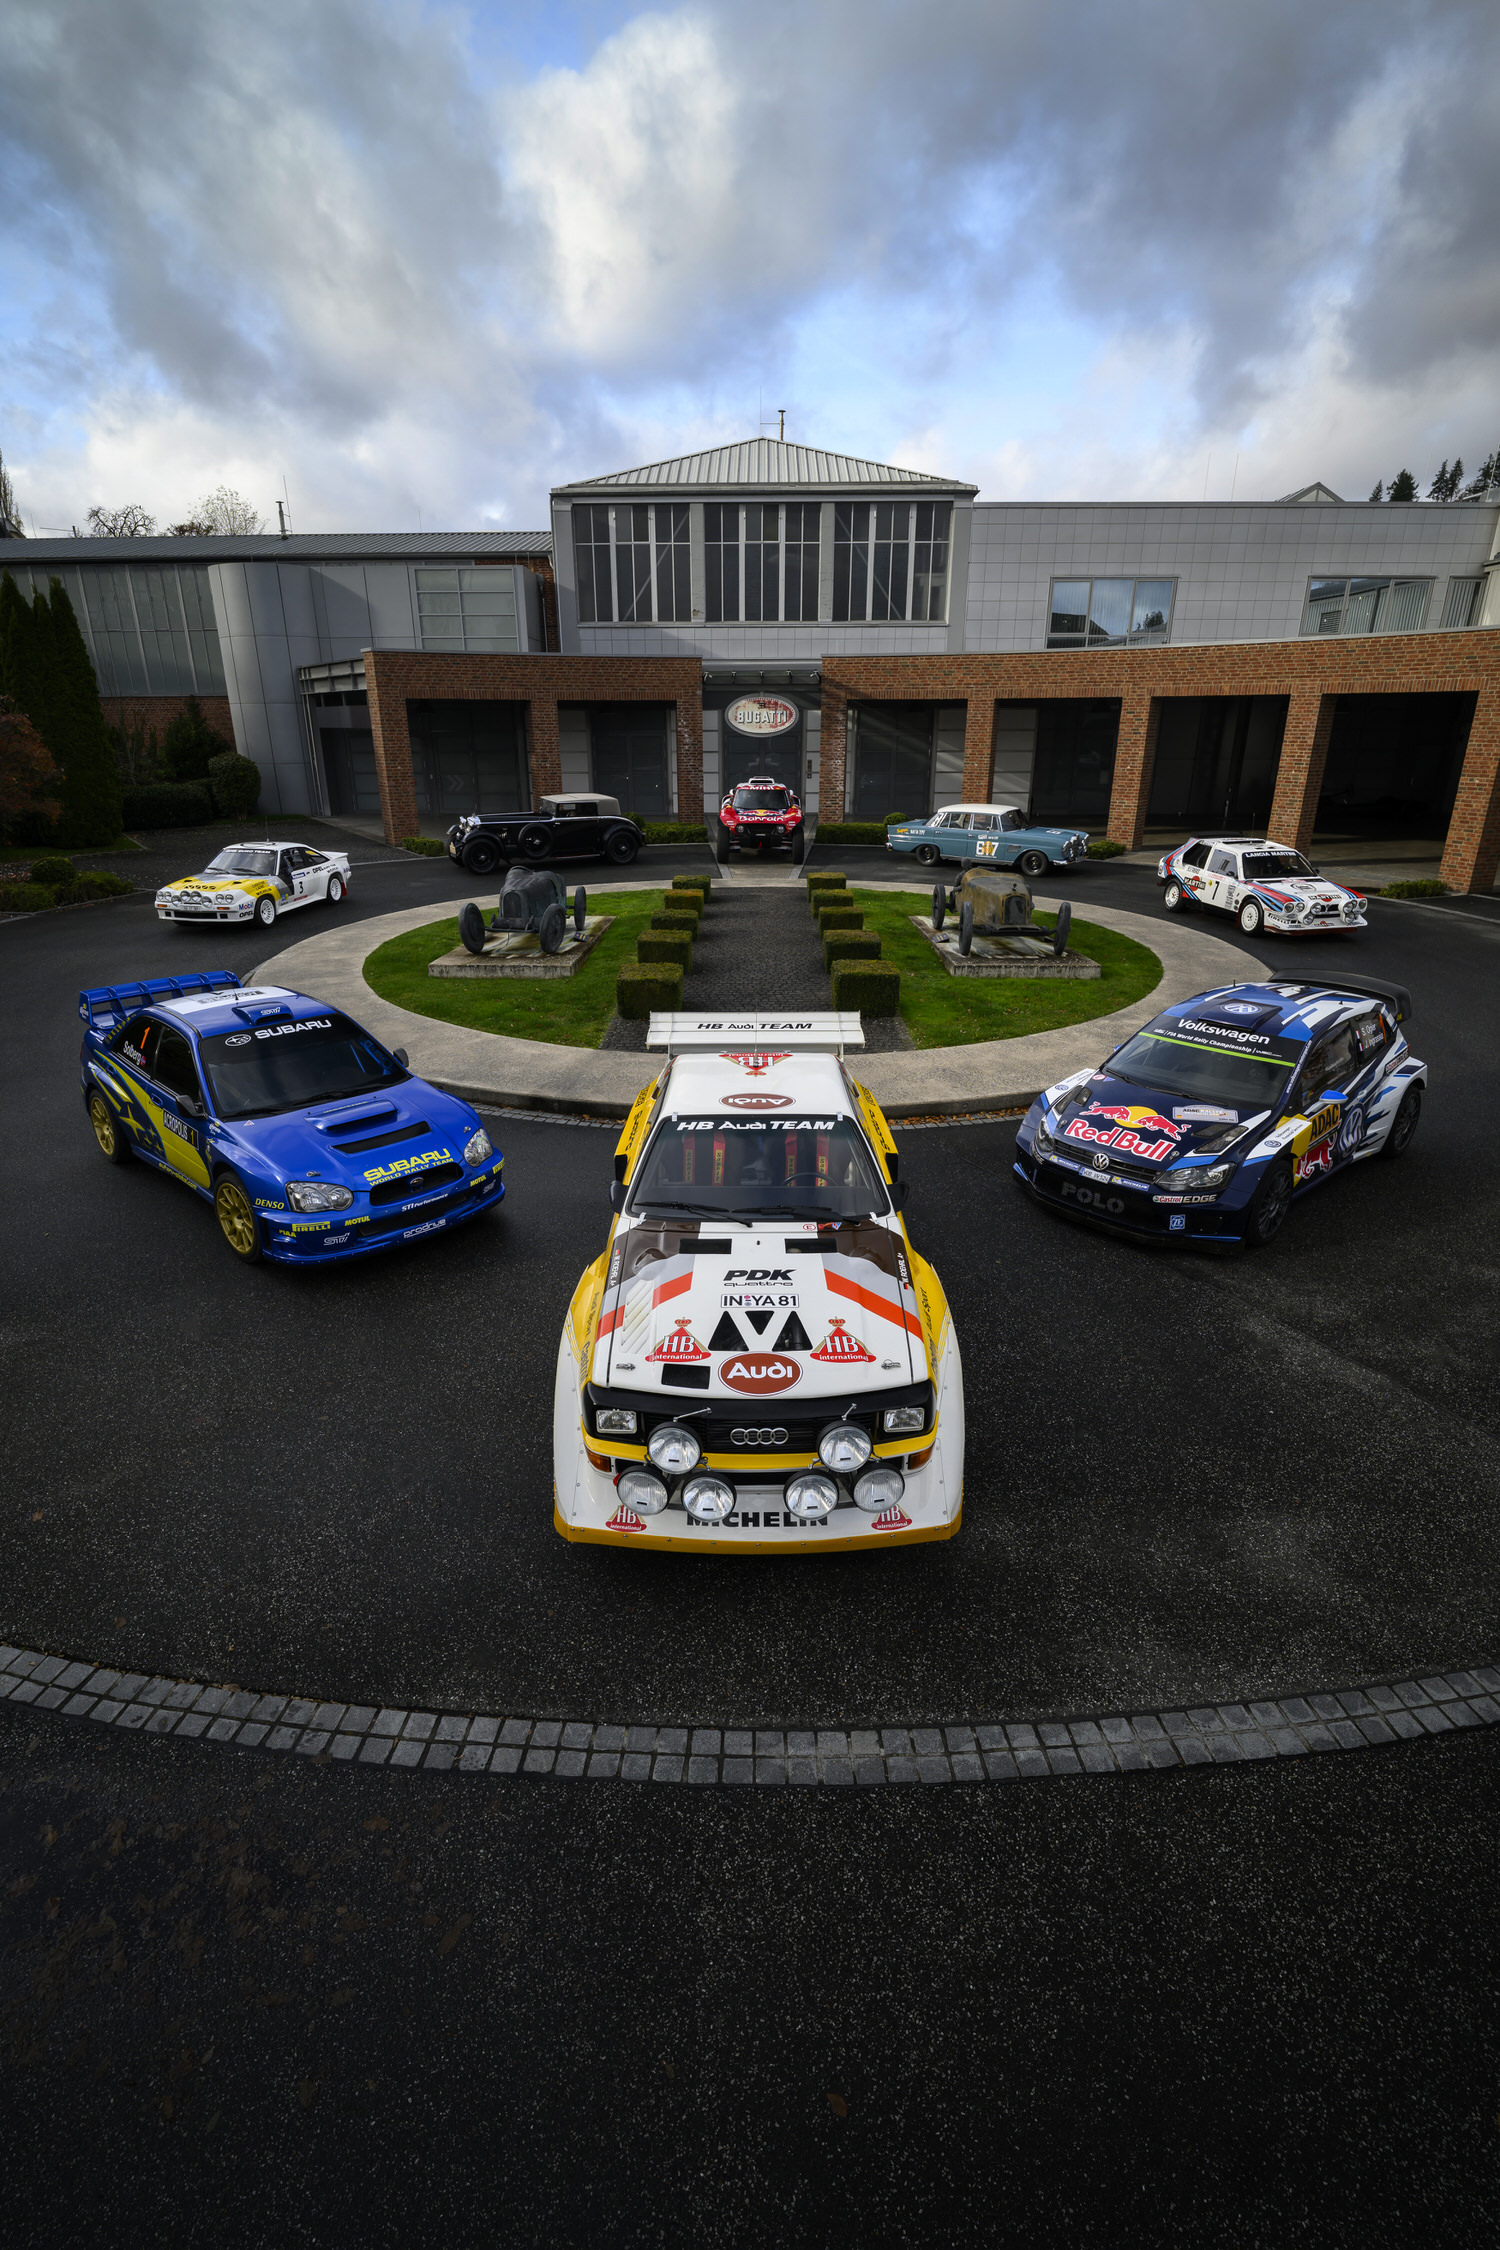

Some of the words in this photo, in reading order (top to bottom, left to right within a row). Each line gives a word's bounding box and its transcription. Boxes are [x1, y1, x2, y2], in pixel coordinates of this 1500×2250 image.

[738, 710, 787, 723] BUGATTI
[299, 881, 304, 894] 3
[1212, 881, 1220, 900] 7
[239, 902, 254, 910] Mobil
[255, 1020, 332, 1039] SUBARU
[1178, 1019, 1270, 1044] Volkswagen
[1366, 1024, 1376, 1034] Ogier
[140, 1026, 150, 1049] 1
[123, 1040, 141, 1066] Solberg
[1209, 1040, 1252, 1053] Championship
[164, 1110, 188, 1140] ACROPOLIS
[191, 1130, 194, 1145] 1
[677, 1121, 715, 1131] HB
[718, 1121, 766, 1130] Audi
[770, 1121, 835, 1130] TEAM
[1310, 1104, 1339, 1142] ADAC
[1064, 1118, 1122, 1145] Red
[1112, 1130, 1176, 1162] Bull
[363, 1148, 451, 1182] SUBARU
[369, 1172, 402, 1187] WORLD
[405, 1164, 430, 1175] RALLY
[431, 1157, 454, 1167] TEAM
[470, 1175, 487, 1187] MOTUL
[1123, 1180, 1148, 1189] MICHELIN
[255, 1198, 285, 1210] DENSO
[401, 1203, 414, 1212] STI
[414, 1193, 448, 1207] Performance
[1061, 1182, 1125, 1214] POLO
[1182, 1194, 1217, 1204] EDGE
[292, 1221, 331, 1232] PIRELLI
[345, 1216, 370, 1226] MOTUL
[404, 1218, 446, 1238] prodrive
[1173, 1218, 1182, 1227] ZF
[723, 1269, 796, 1281] PDK
[723, 1296, 742, 1306] IN
[751, 1296, 776, 1306] YA
[778, 1296, 797, 1306] 81
[662, 1335, 696, 1353] HB
[824, 1335, 859, 1353] HB
[726, 1362, 793, 1379] Audi
[617, 1506, 637, 1523] HB
[881, 1506, 900, 1522] HB
[876, 1521, 908, 1529] international
